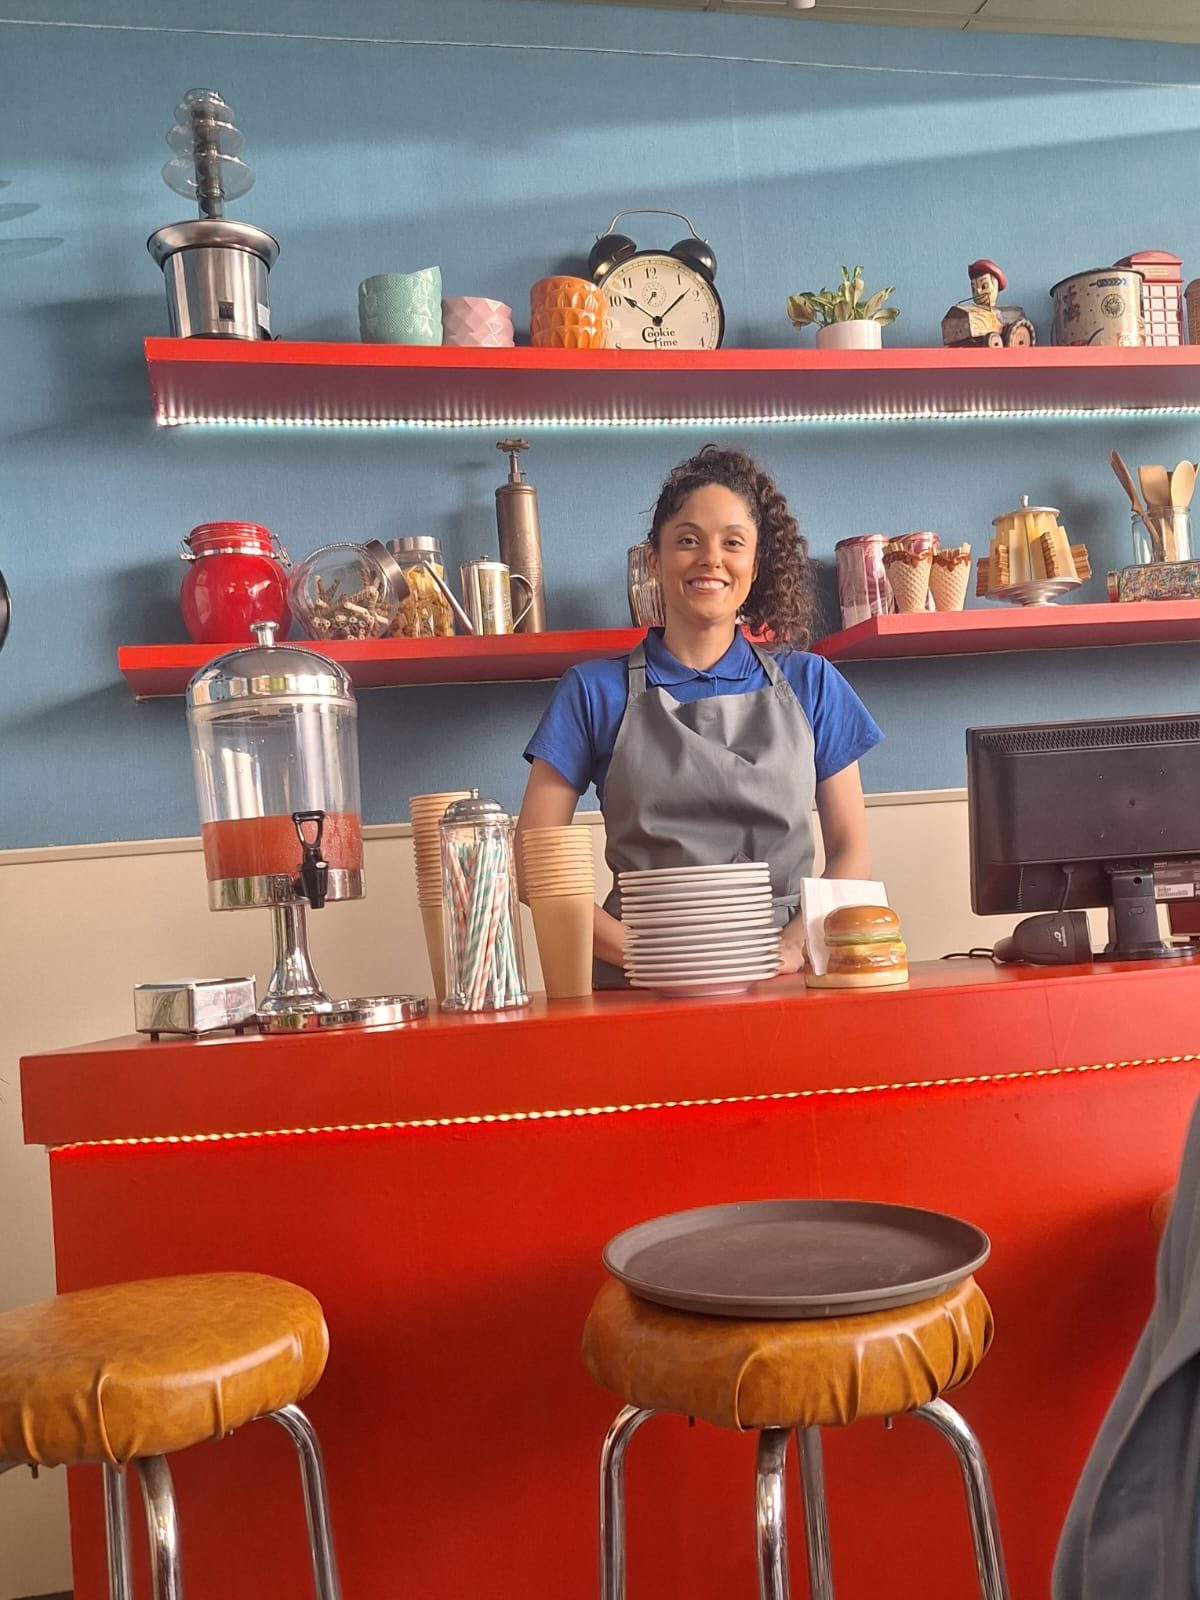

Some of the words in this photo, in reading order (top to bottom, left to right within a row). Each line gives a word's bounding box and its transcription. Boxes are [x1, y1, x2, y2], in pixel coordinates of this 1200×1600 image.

[645, 267, 657, 280] 12
[677, 273, 681, 286] 1
[622, 277, 633, 289] 11
[609, 295, 622, 308] 10
[691, 290, 700, 302] 2
[605, 318, 613, 330] 9
[701, 311, 709, 324] 3
[641, 326, 676, 344] Cookie
[697, 335, 705, 348] 4
[653, 337, 678, 349] Time
